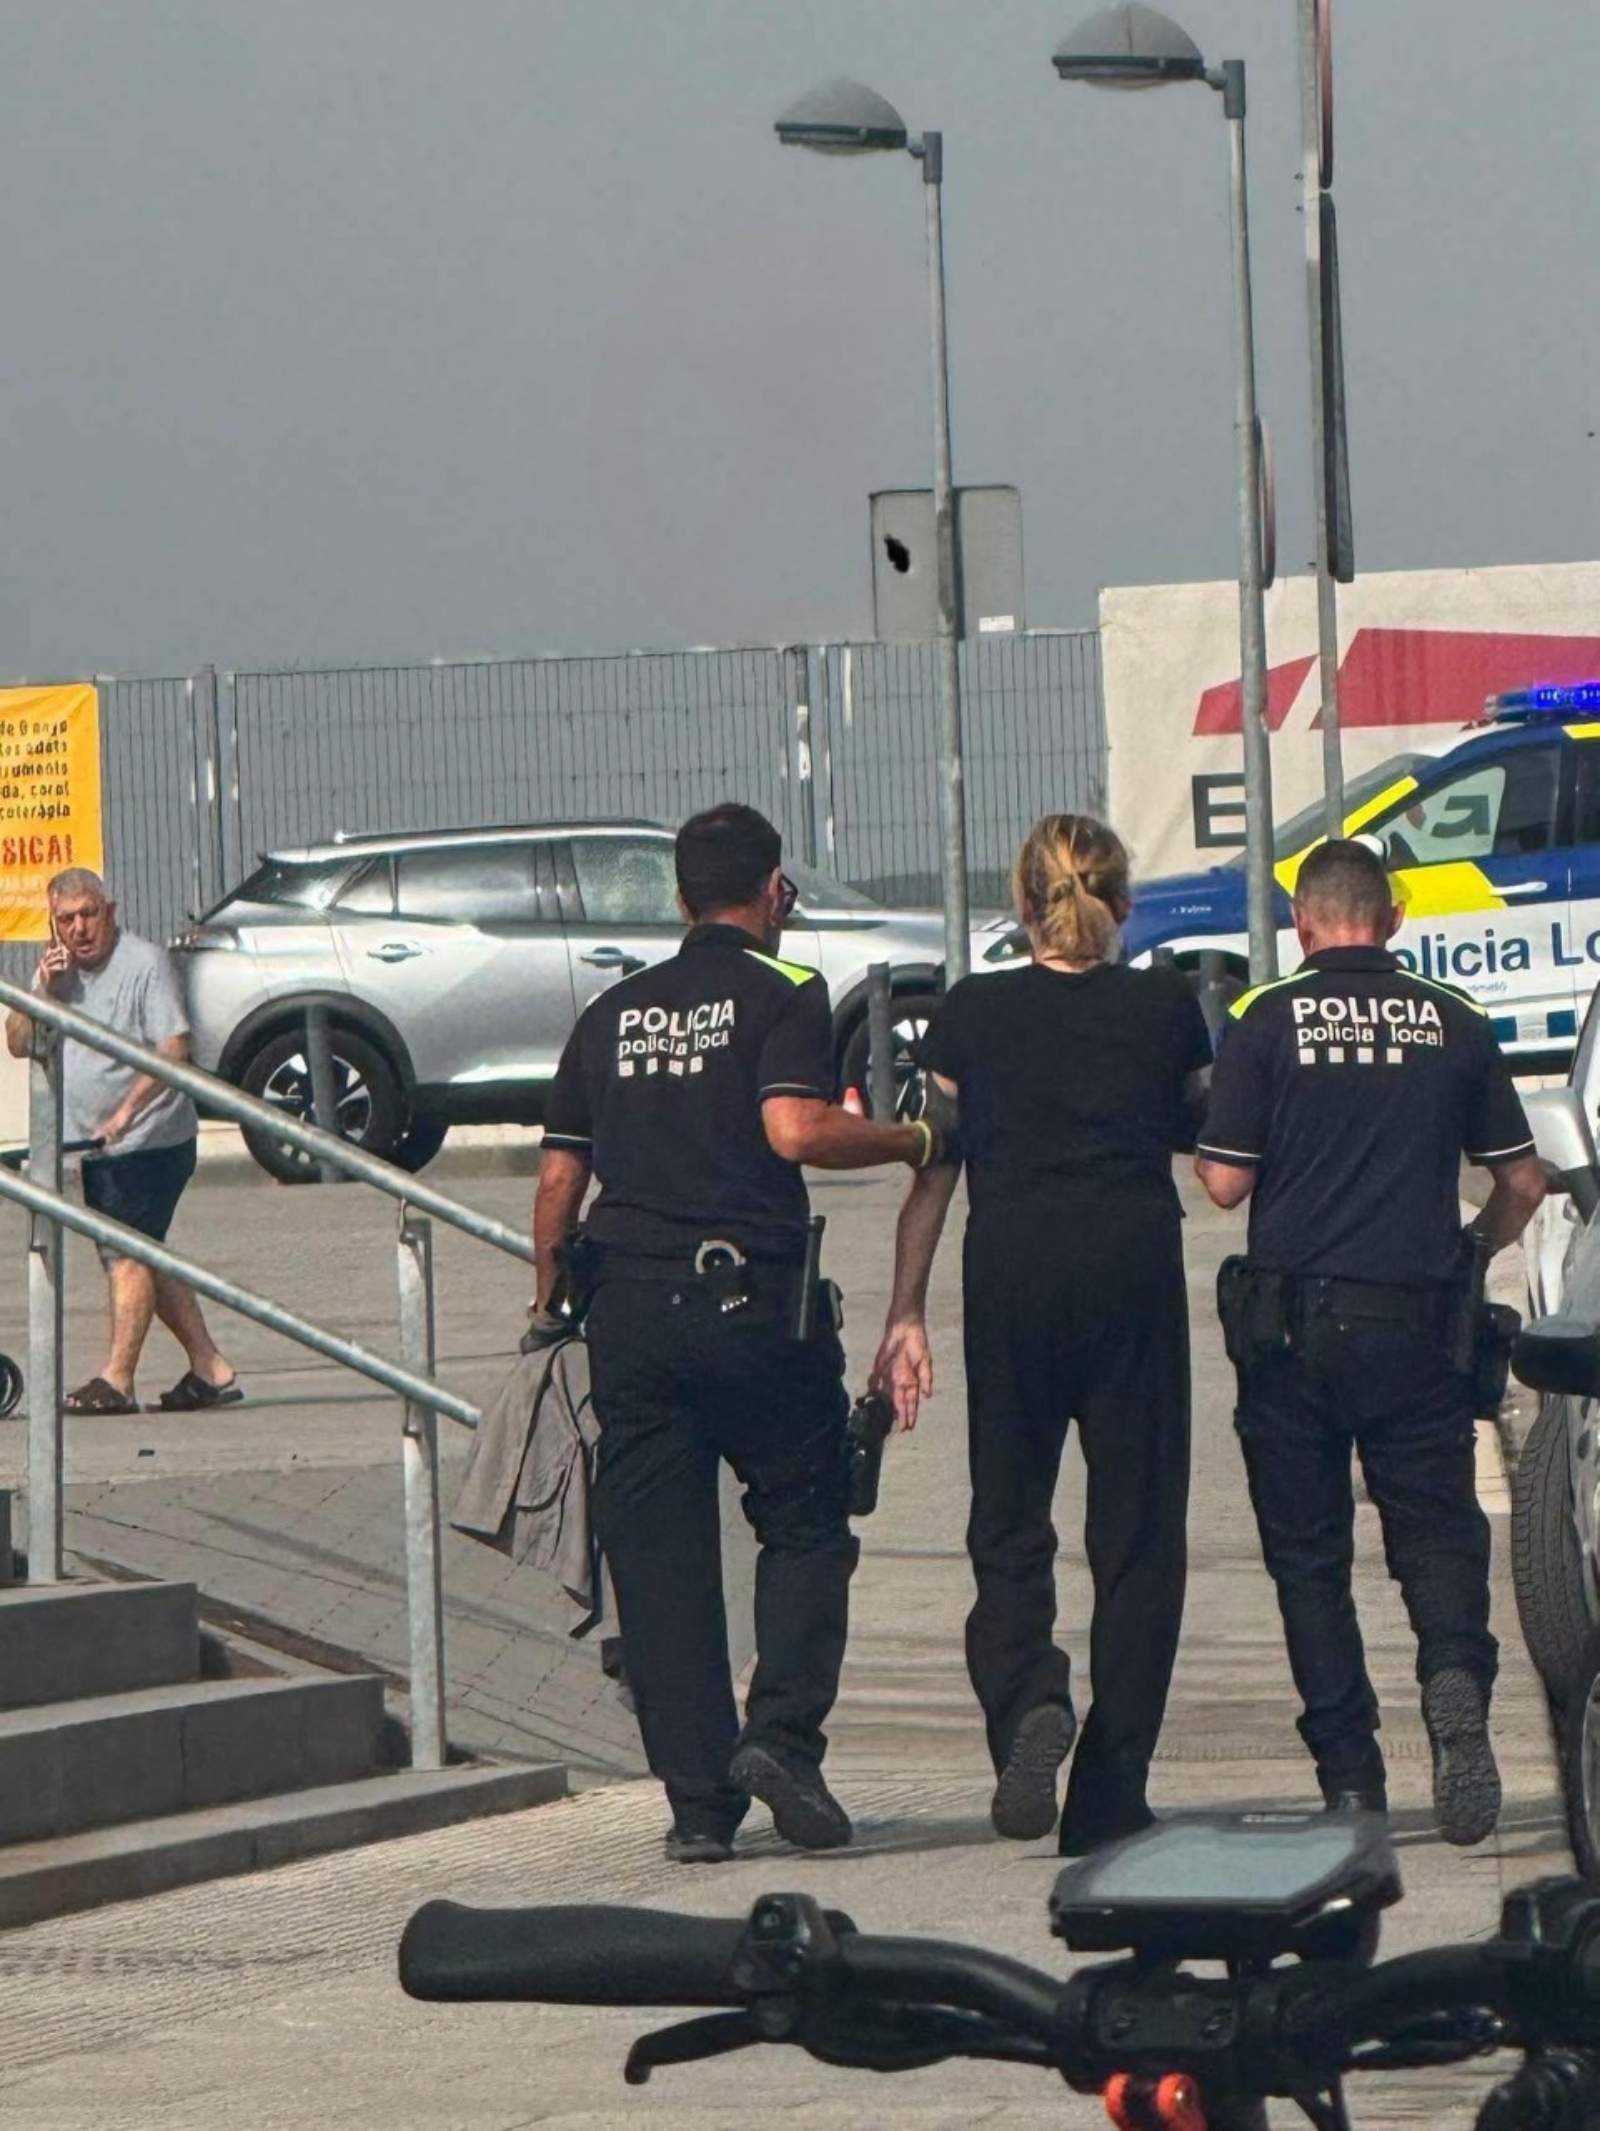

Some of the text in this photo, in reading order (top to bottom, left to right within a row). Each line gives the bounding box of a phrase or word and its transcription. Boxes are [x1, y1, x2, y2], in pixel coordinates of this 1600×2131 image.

[1392, 928, 1530, 979] olicia
[619, 999, 735, 1036] POLICIA
[1292, 997, 1441, 1027] POLICIA
[618, 1033, 688, 1060] policia
[1297, 1021, 1443, 1047] policia local
